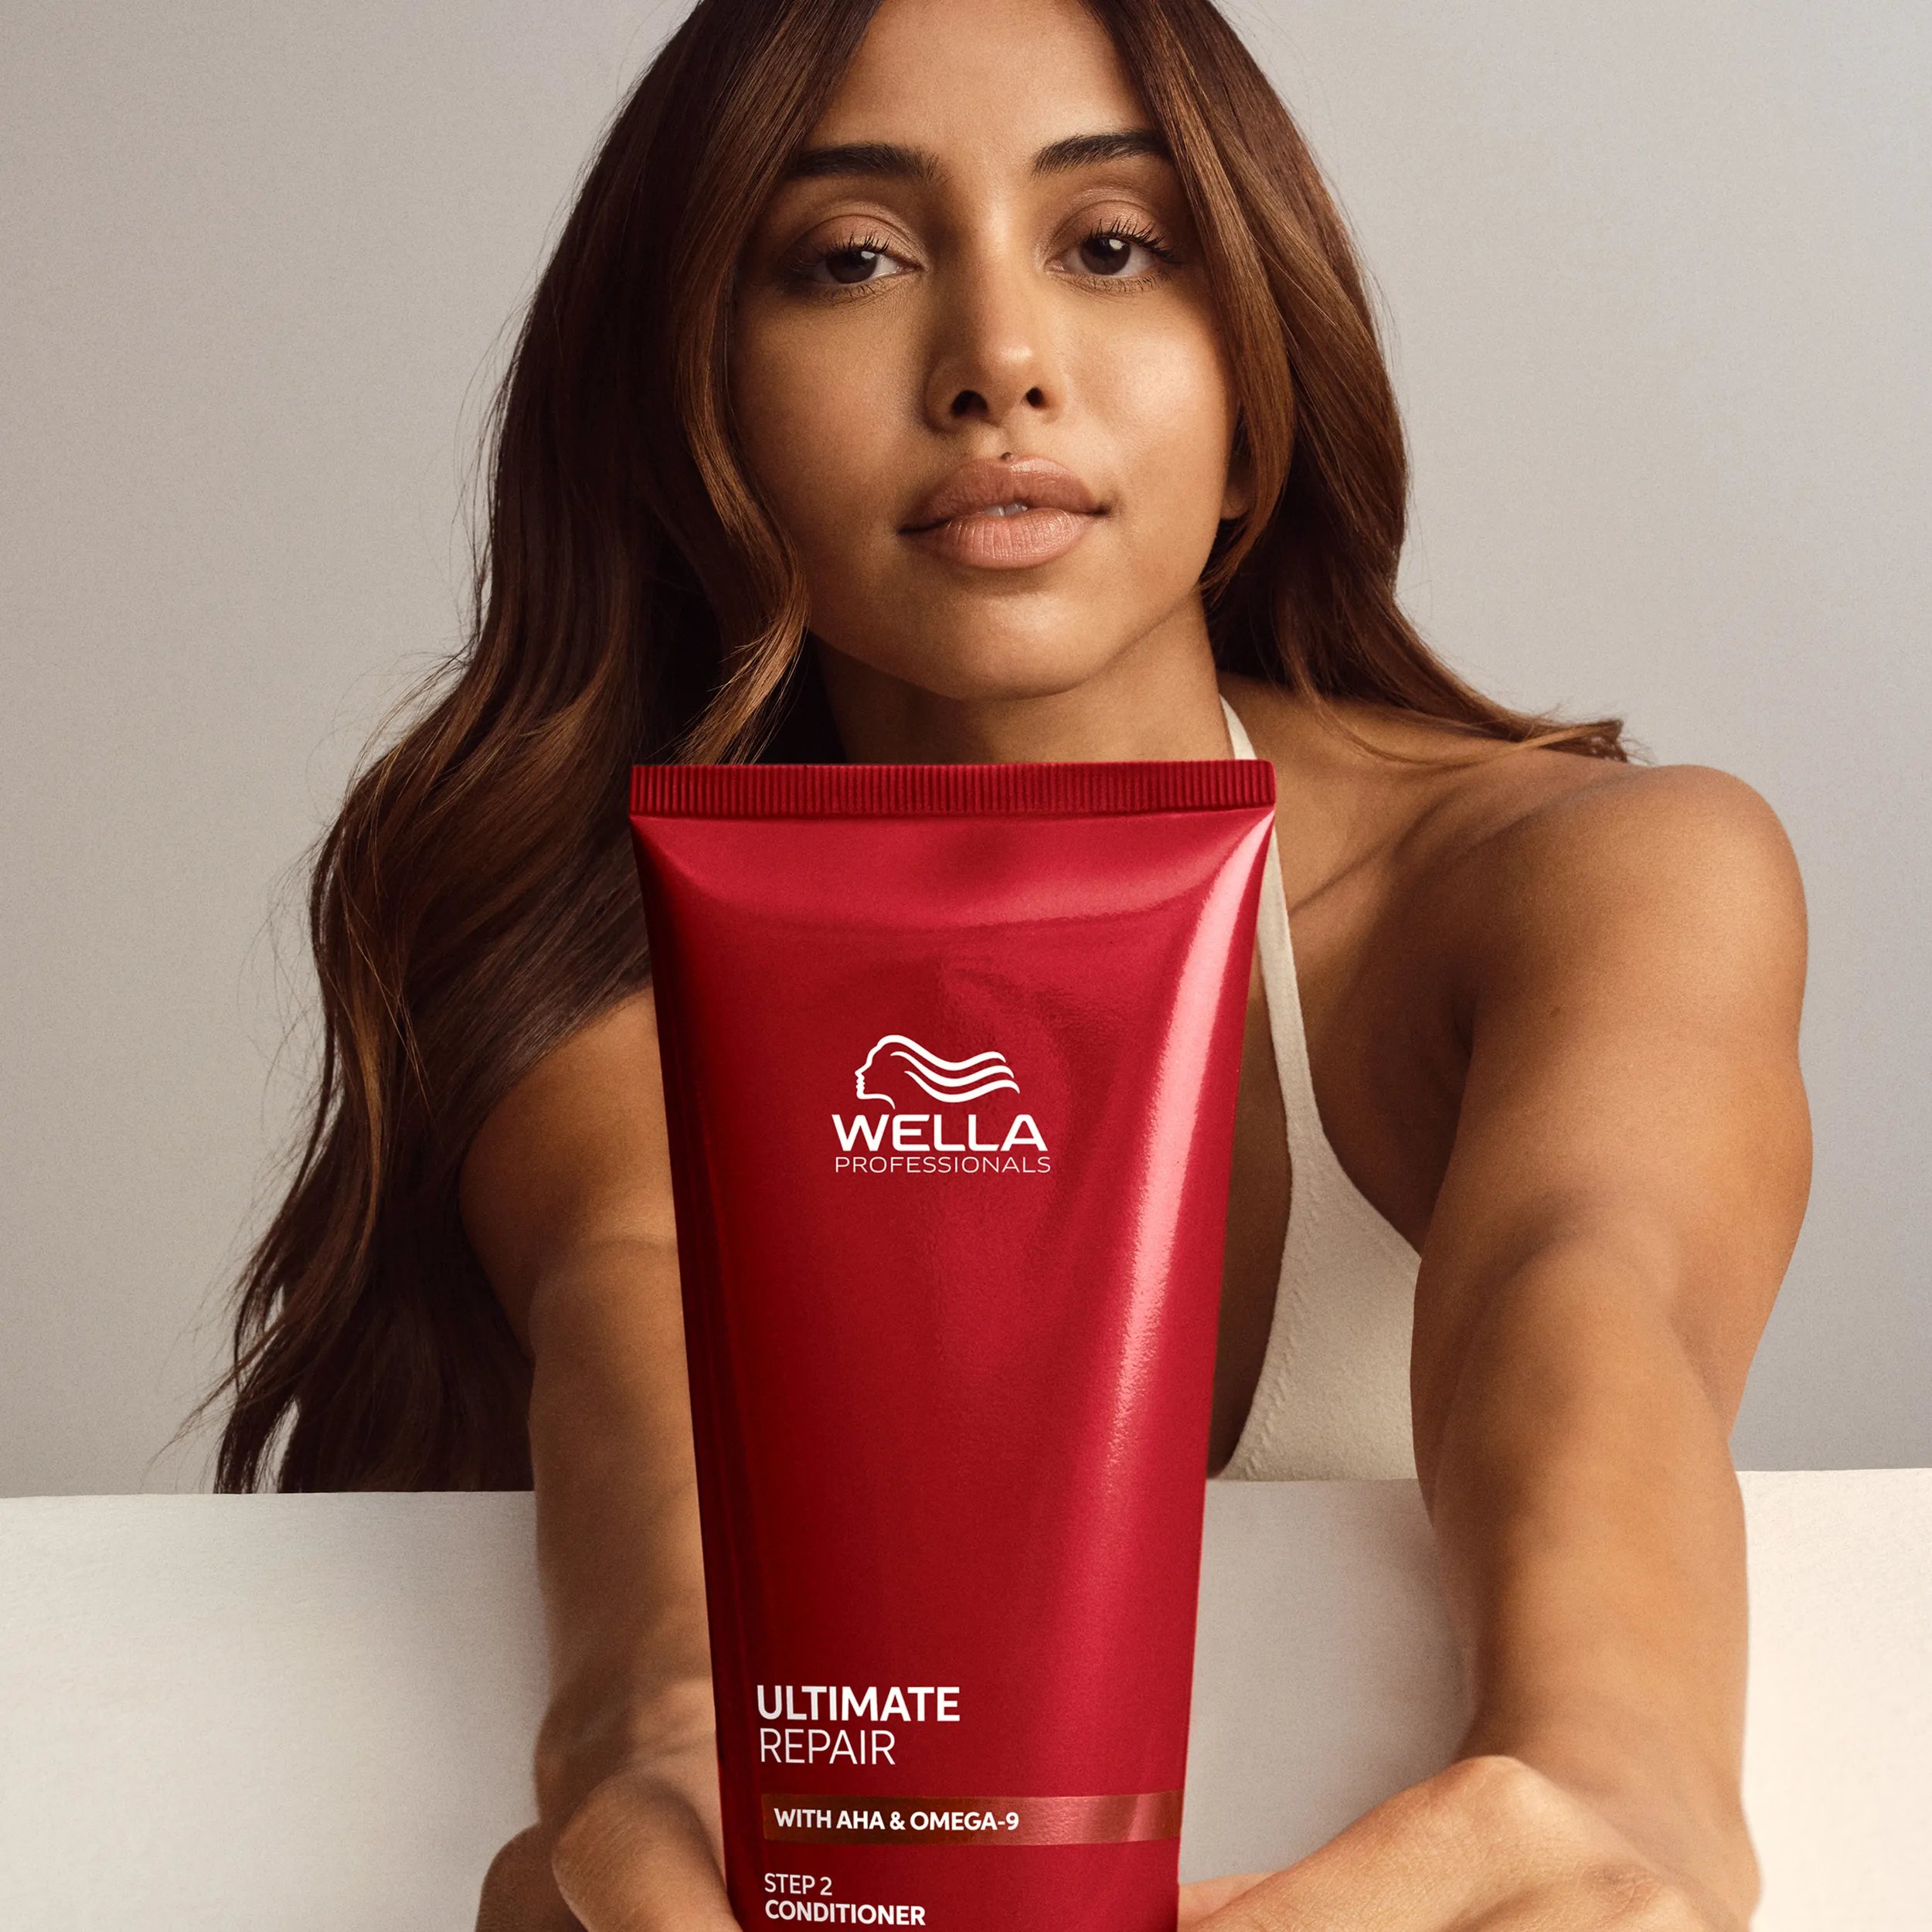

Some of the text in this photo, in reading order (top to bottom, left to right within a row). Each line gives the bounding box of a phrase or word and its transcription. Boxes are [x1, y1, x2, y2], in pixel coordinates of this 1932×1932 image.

[831, 1114, 1049, 1151] WELLA
[835, 1156, 1052, 1173] PROFESSIONALS
[757, 1684, 961, 1722] ULTIMATE
[759, 1727, 896, 1765] REPAIR
[774, 1808, 1020, 1831] WITH AHA & OMEGA-9
[764, 1872, 833, 1896] STEP 2
[764, 1899, 926, 1927] CONDITIONER
